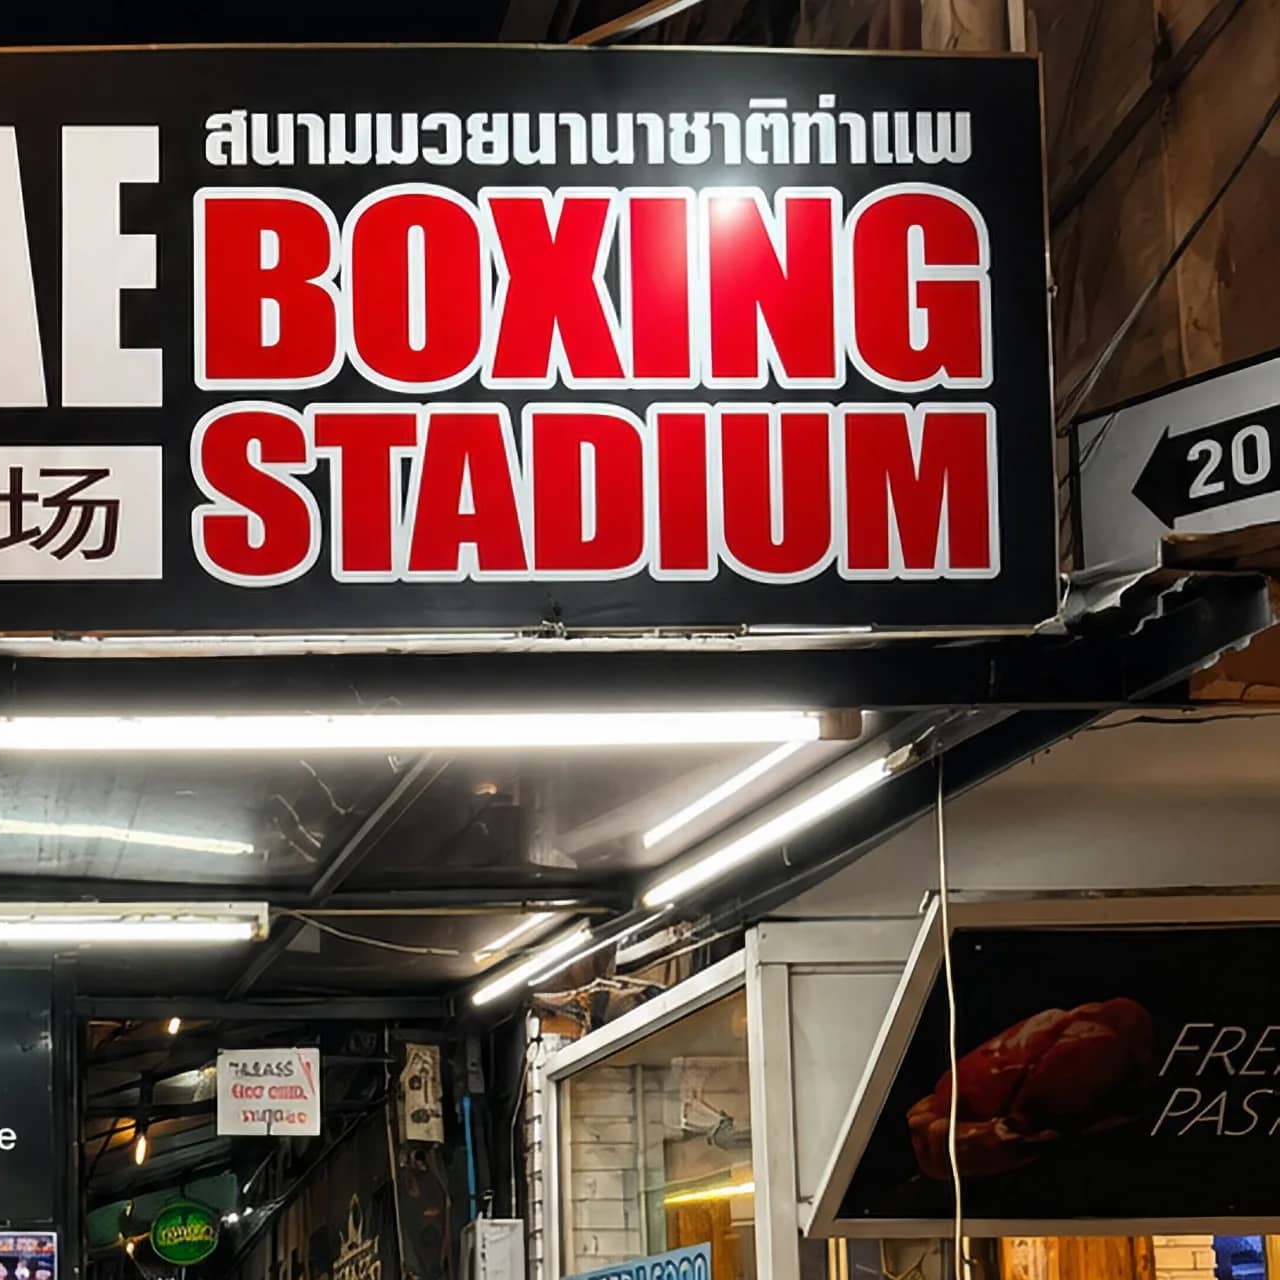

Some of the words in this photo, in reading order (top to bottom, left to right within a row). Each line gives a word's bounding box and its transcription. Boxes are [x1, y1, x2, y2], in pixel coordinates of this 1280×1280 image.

[205, 94, 972, 165] สนามมวยนานาชาติท่าแพ
[193, 182, 994, 394] BOXING
[190, 400, 1001, 585] STADIUM
